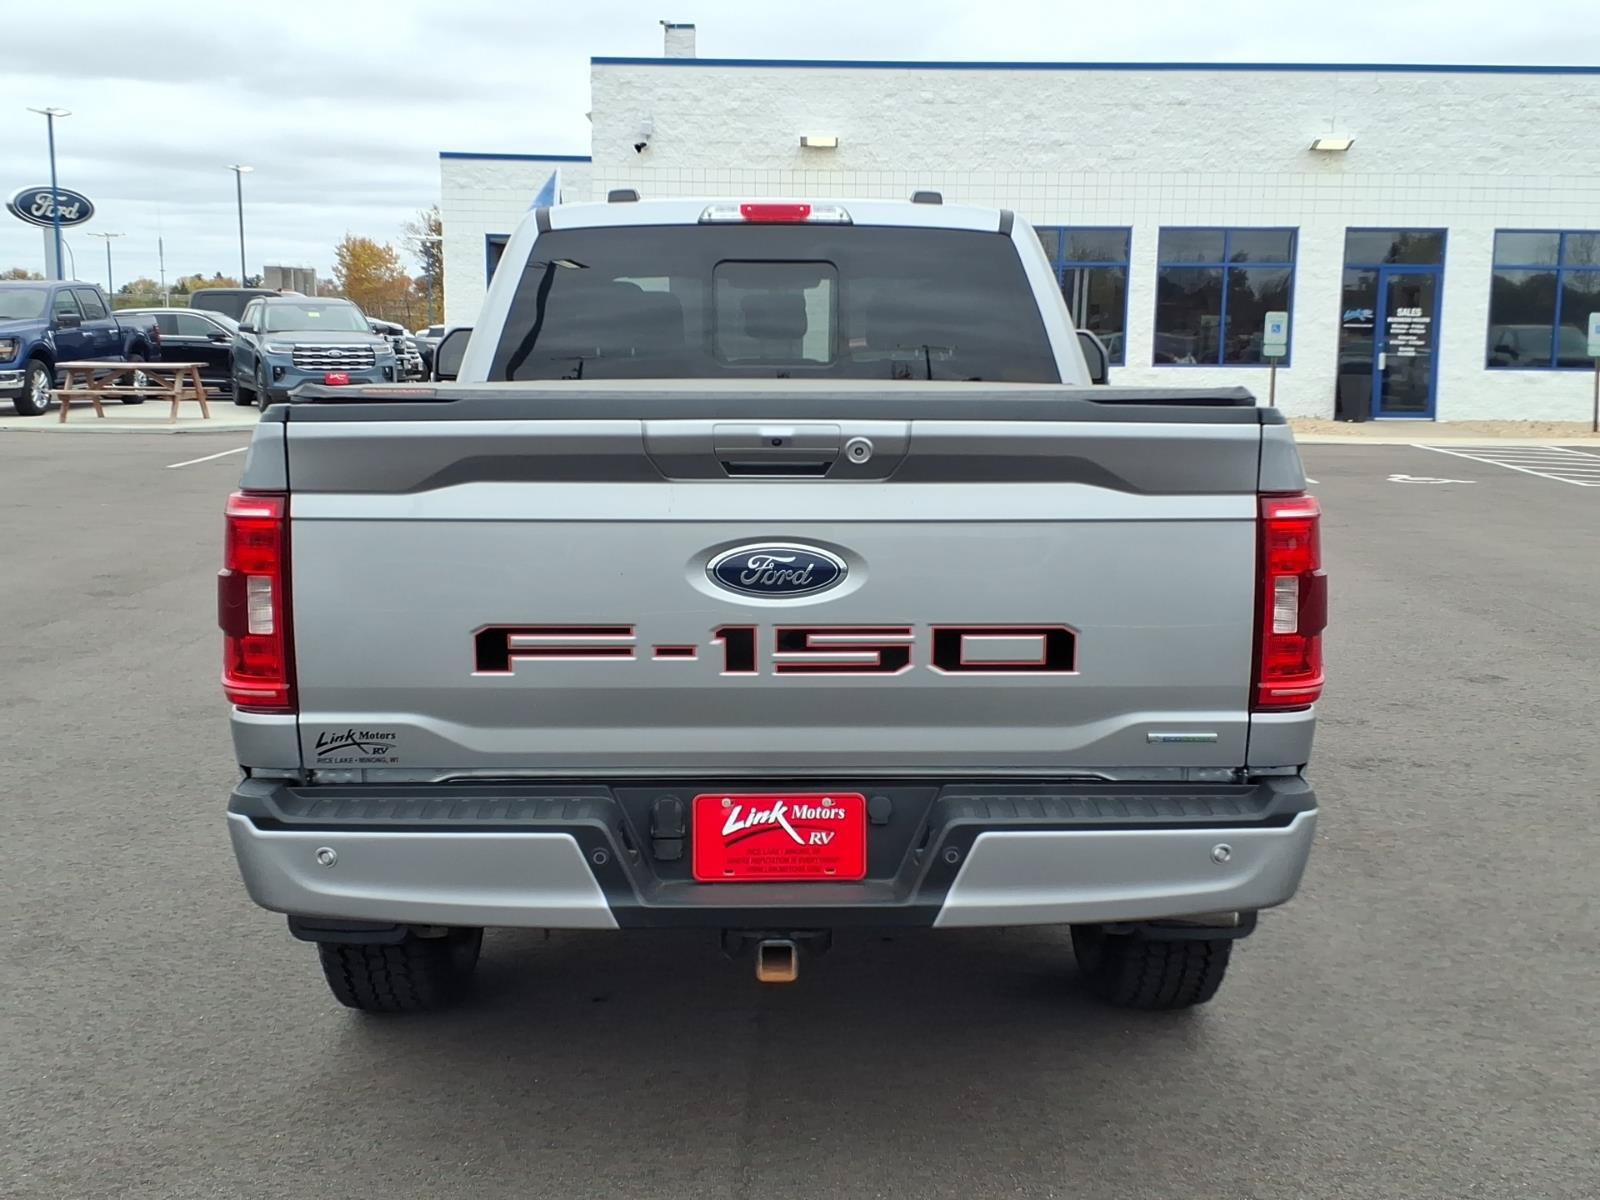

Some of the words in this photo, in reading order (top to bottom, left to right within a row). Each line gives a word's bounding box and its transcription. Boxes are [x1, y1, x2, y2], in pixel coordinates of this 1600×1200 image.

[30, 192, 80, 220] Ford
[1396, 307, 1422, 317] SALES
[739, 553, 815, 585] Ford
[470, 623, 1081, 676] F-150
[315, 728, 370, 755] Link
[358, 730, 396, 740] Motors
[372, 745, 389, 755] RV
[721, 800, 806, 845] Link
[791, 804, 846, 820] Motors
[808, 831, 835, 845] RV
